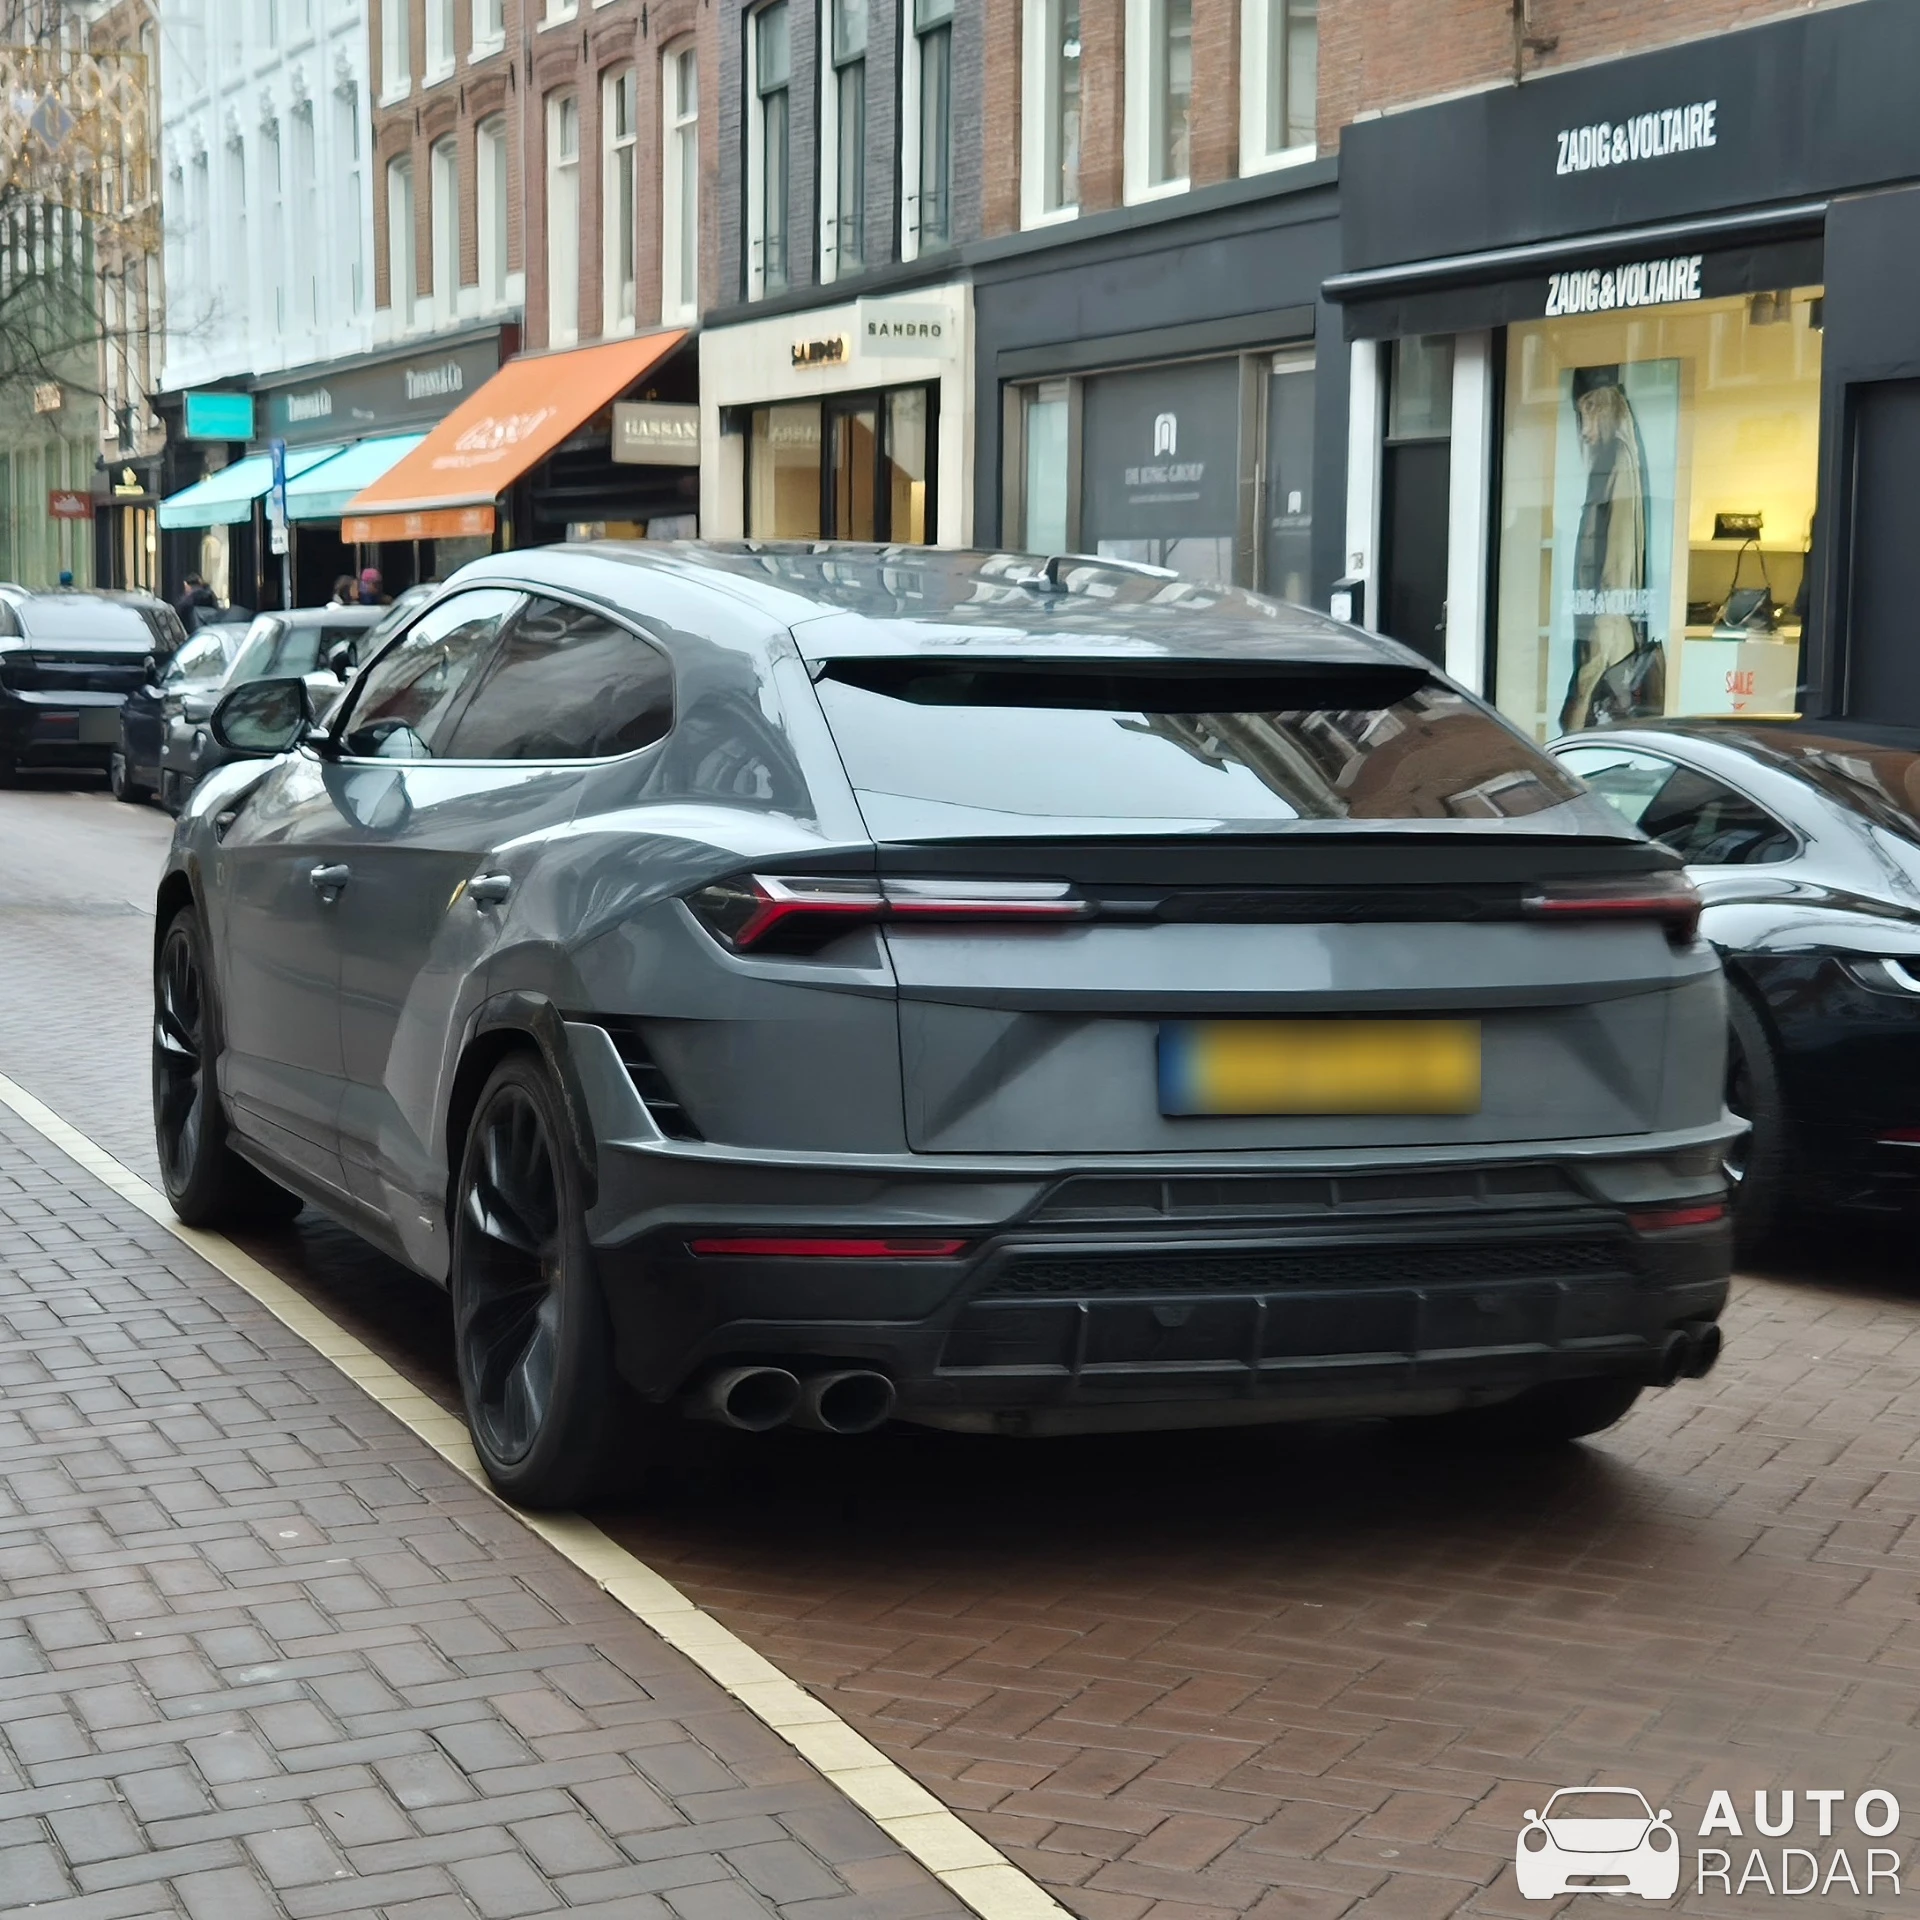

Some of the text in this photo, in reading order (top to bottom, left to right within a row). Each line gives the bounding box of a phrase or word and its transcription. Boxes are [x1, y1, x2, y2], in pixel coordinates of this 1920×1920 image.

[1556, 100, 1717, 175] ZADIG&VOLTAIRE
[1545, 256, 1703, 317] ZADIG&VOLTAIRE
[868, 322, 942, 338] SANDRO
[1725, 670, 1754, 695] SALE
